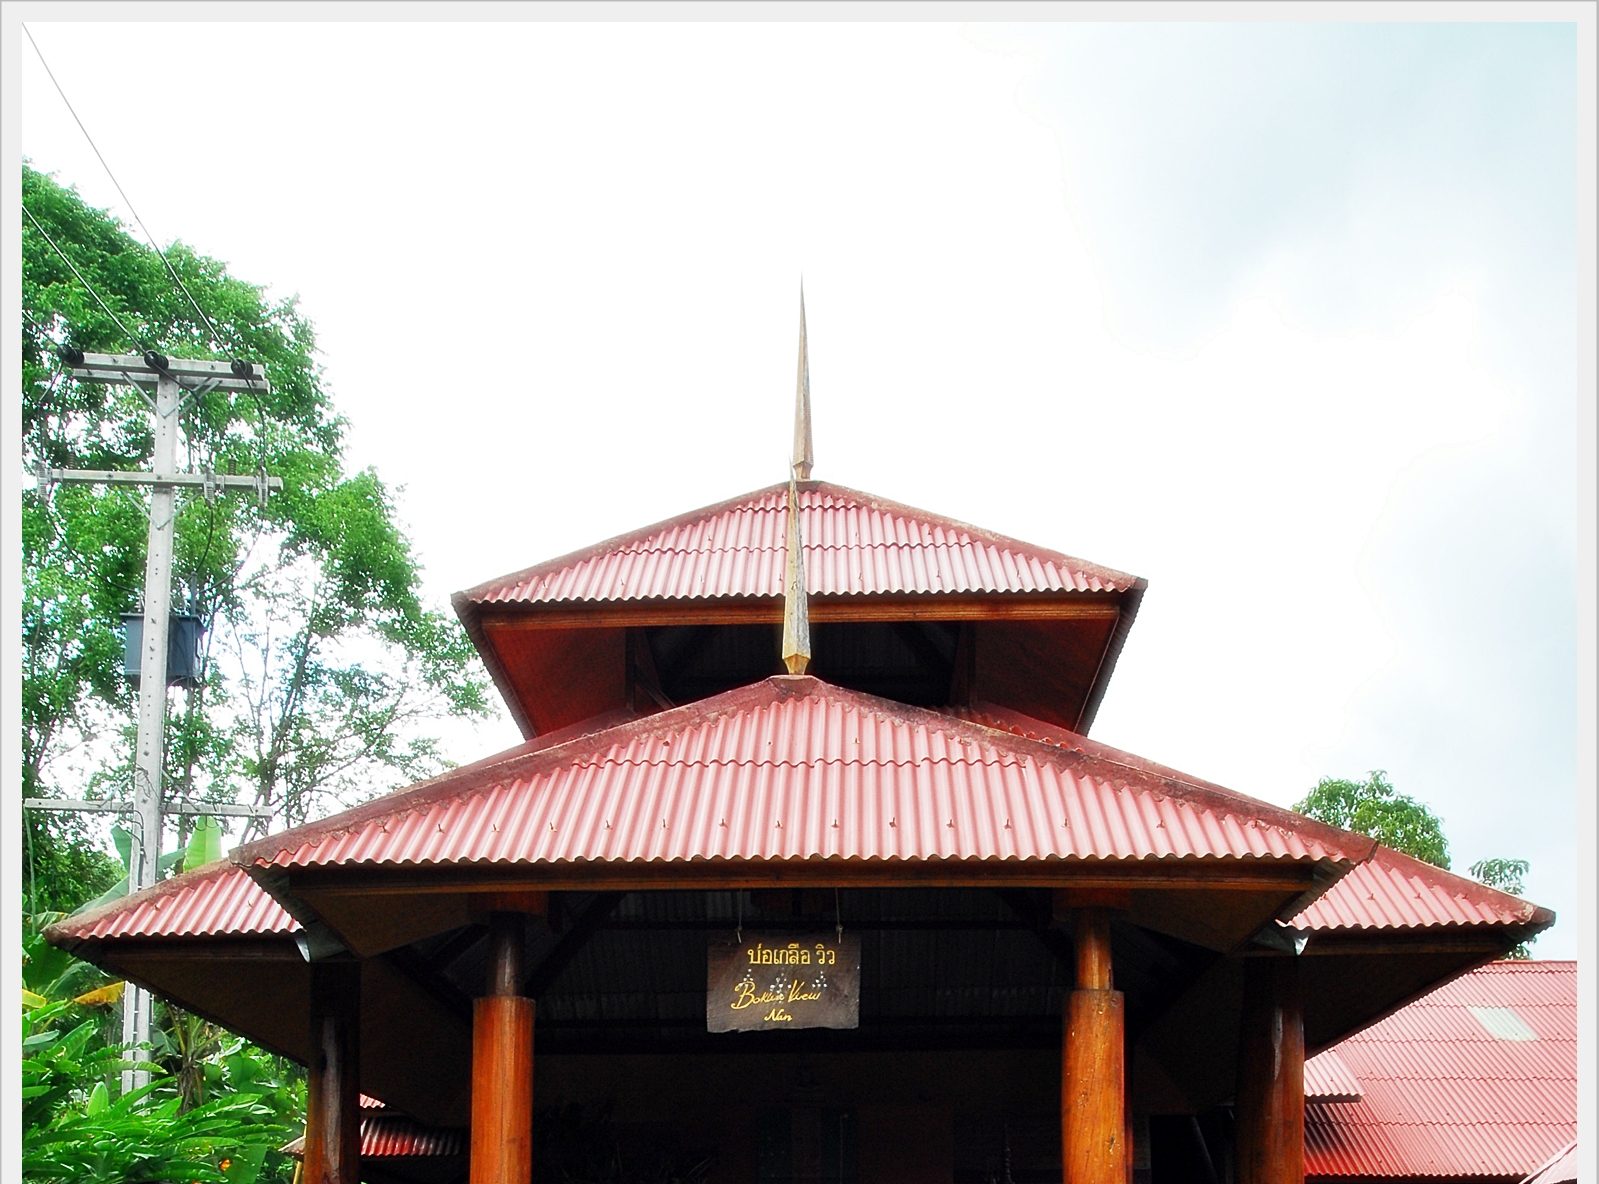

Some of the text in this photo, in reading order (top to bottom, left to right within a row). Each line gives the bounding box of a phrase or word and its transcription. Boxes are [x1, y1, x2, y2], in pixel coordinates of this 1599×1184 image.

[747, 943, 836, 965] บ่อเกลือ วิว
